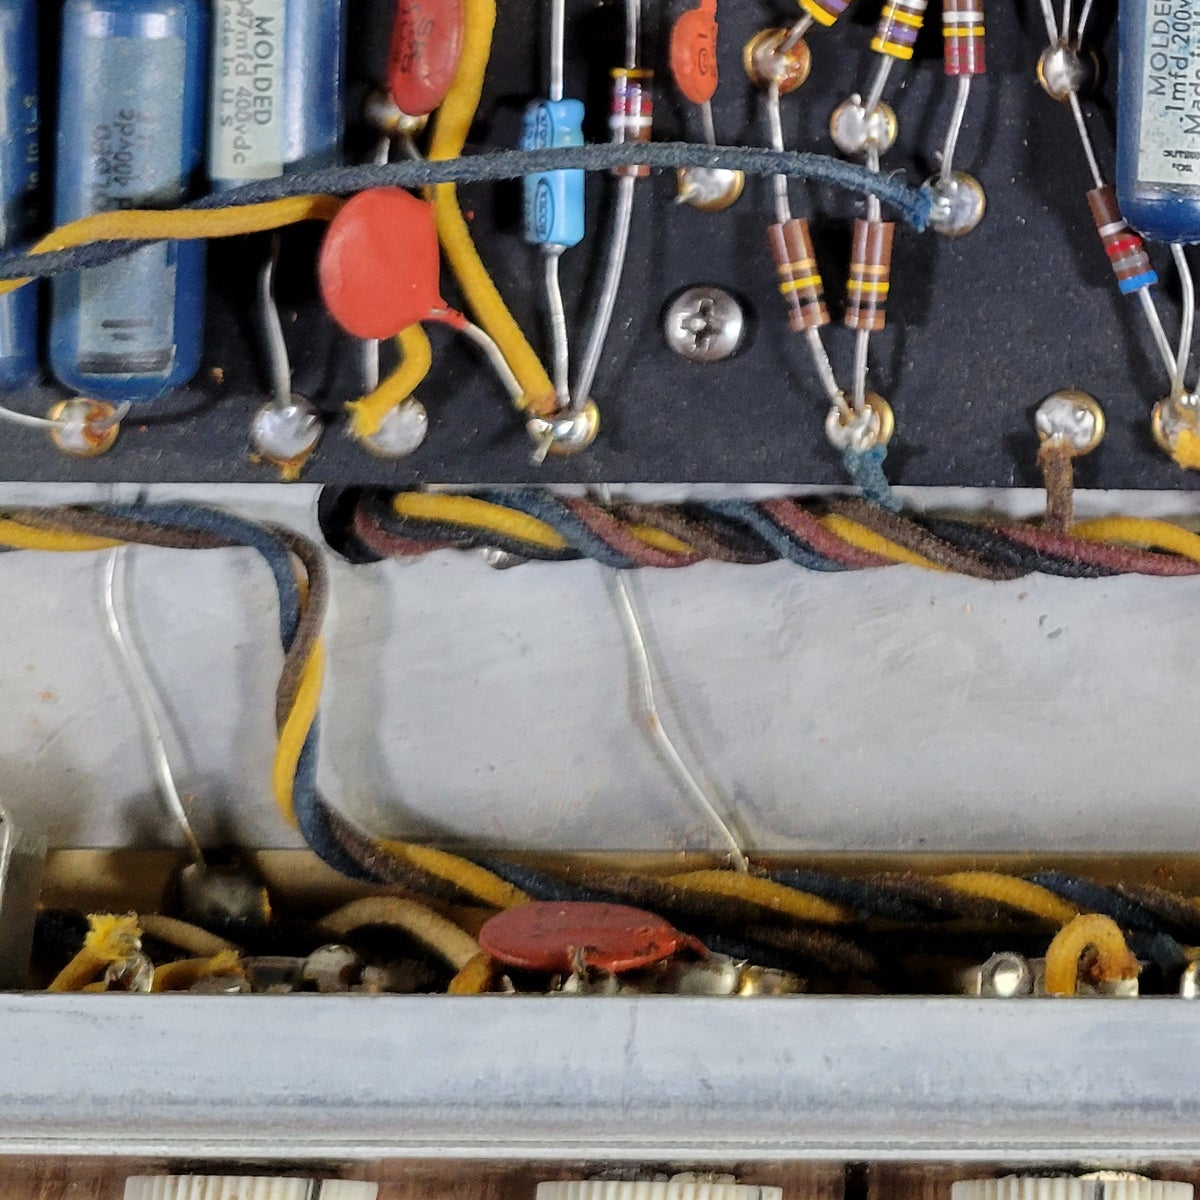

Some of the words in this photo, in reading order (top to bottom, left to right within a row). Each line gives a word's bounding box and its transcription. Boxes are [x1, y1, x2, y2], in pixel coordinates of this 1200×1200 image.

[253, 16, 275, 125] MOLDED
[1165, 56, 1188, 122] .1mfd
[234, 87, 254, 165] 400vdc
